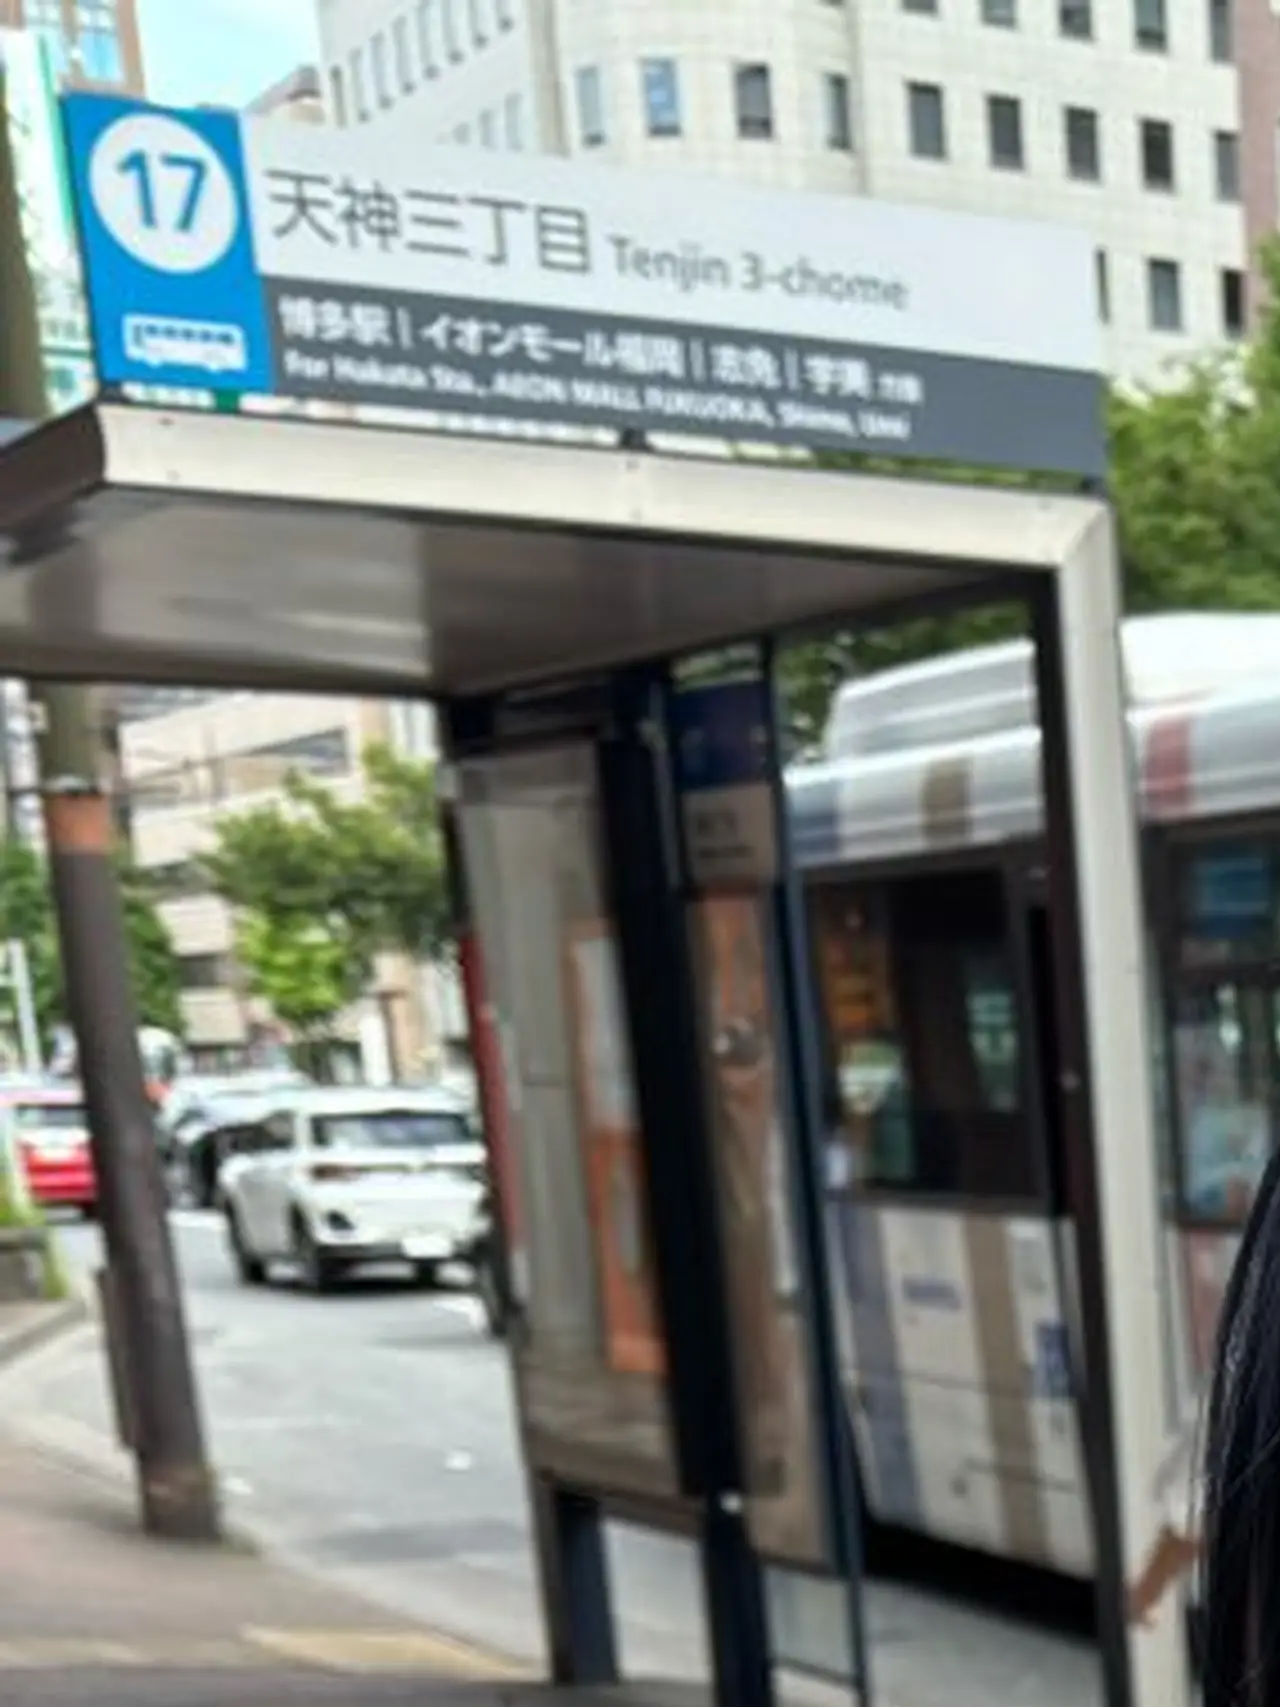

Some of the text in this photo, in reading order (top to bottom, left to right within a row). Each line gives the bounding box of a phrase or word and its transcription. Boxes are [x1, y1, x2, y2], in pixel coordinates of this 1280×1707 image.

[117, 149, 208, 231] 17
[265, 169, 591, 275] 天神三丁目
[608, 234, 910, 310] Tenjin 3-chome
[284, 349, 330, 379] For
